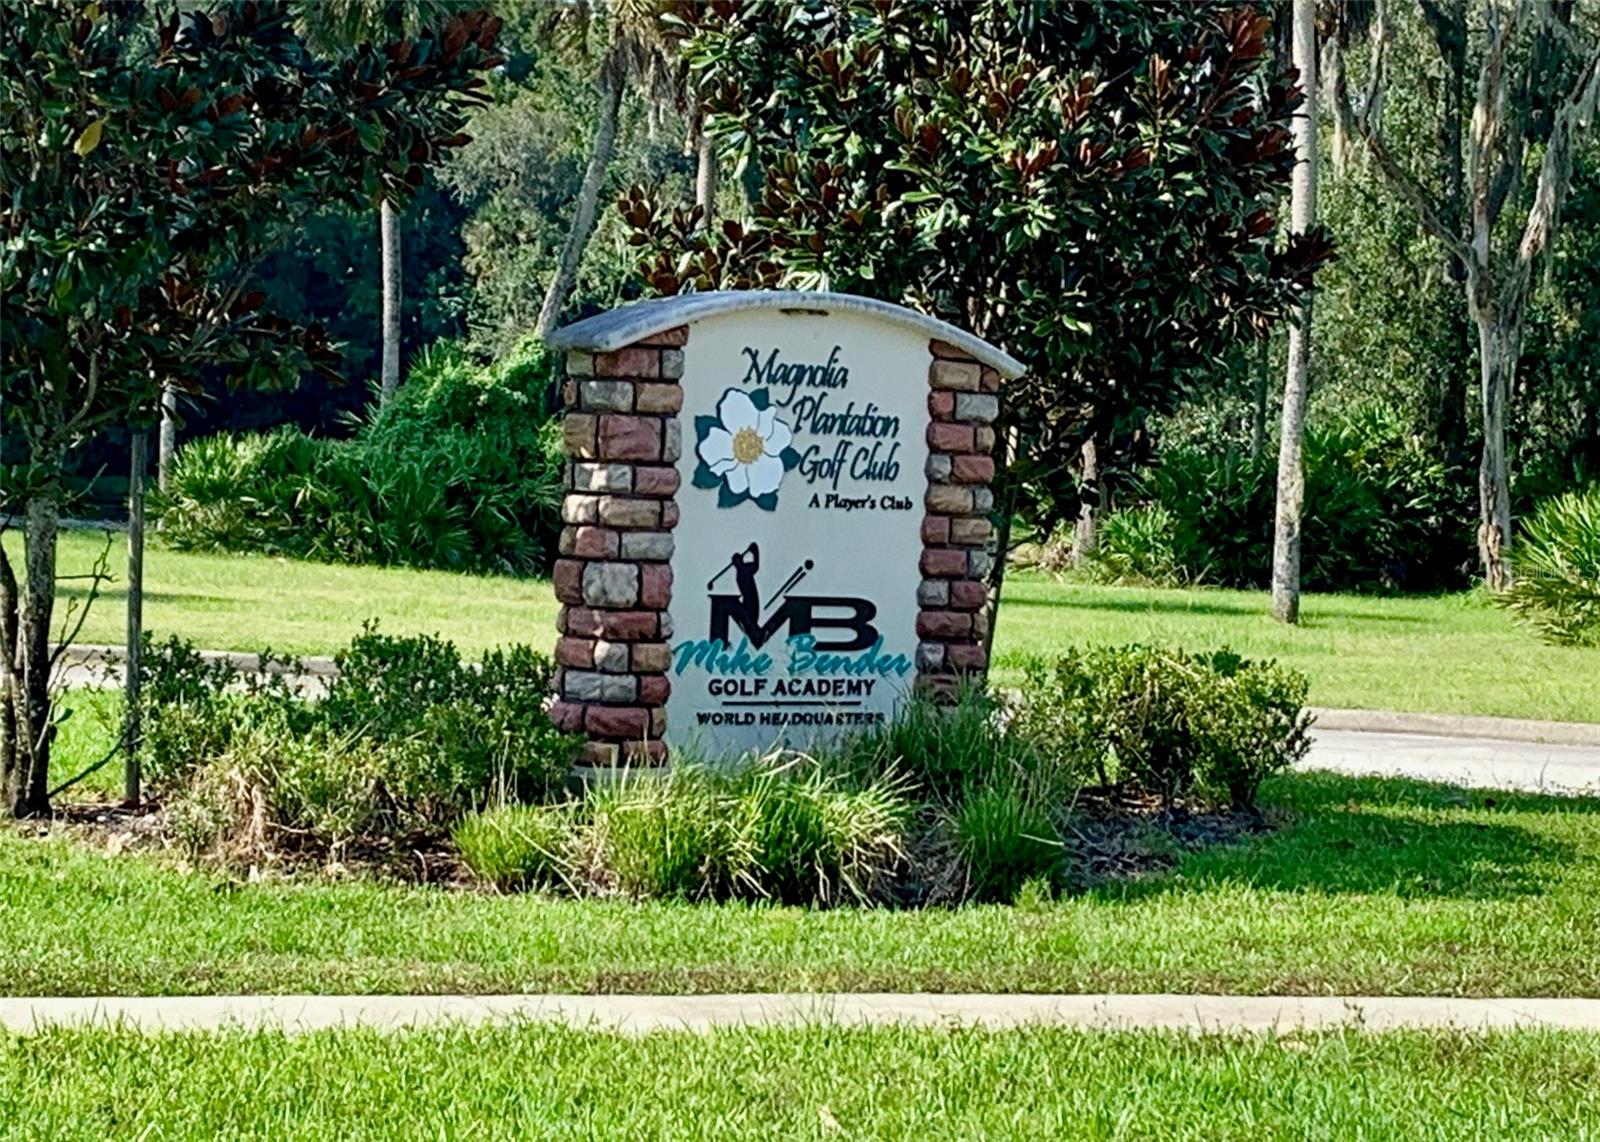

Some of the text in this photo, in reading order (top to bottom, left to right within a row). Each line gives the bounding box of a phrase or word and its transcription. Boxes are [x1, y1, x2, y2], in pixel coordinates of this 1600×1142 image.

[741, 345, 849, 406] Magnolia
[792, 391, 900, 438] Plantation
[799, 439, 901, 491] Golf Club
[808, 493, 913, 511] A Player's Club
[671, 633, 913, 678] Mike Bender
[708, 678, 877, 697] GOLF ACADEMY
[697, 711, 755, 726] WORLD
